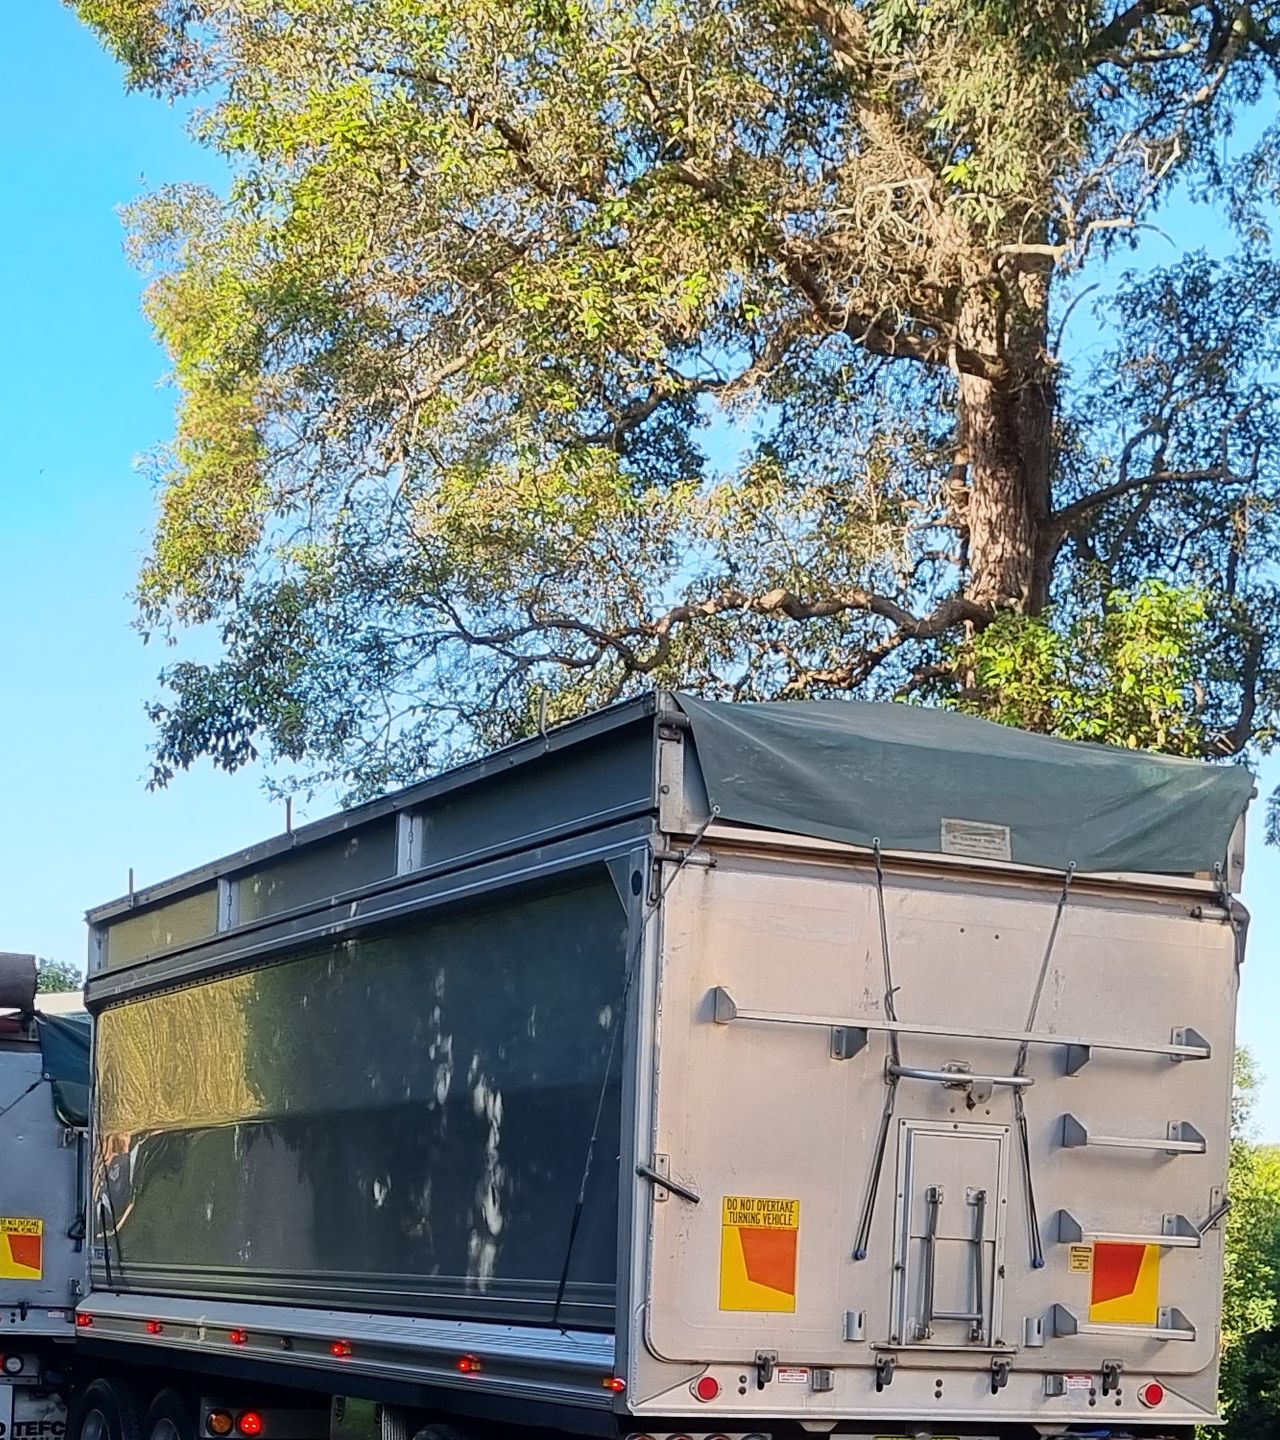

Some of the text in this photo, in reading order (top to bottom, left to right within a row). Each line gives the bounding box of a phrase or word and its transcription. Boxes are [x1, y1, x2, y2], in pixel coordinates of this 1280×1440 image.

[726, 1199, 794, 1213] DO NOT OVERTAKE
[729, 1211, 793, 1225] TURNING VEHICLE
[13, 1421, 67, 1437] TEFC
